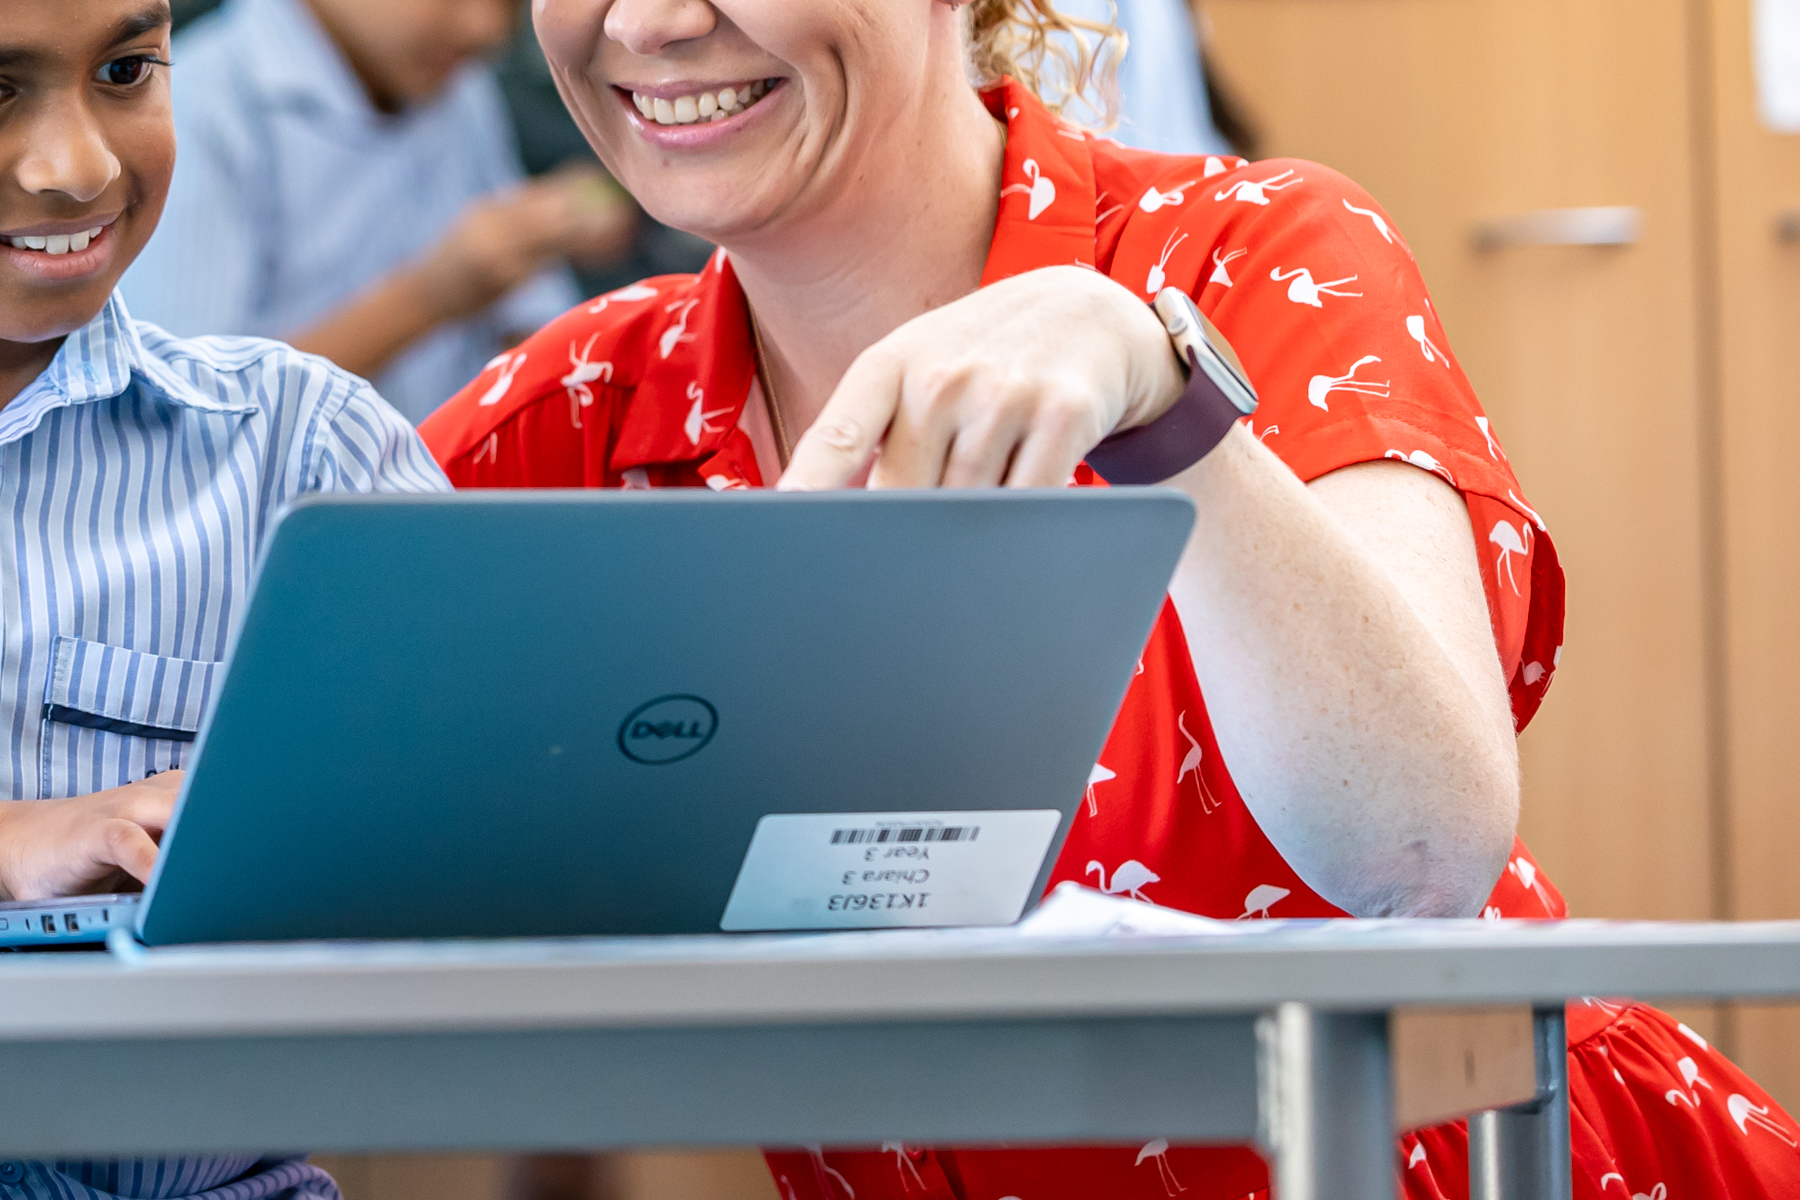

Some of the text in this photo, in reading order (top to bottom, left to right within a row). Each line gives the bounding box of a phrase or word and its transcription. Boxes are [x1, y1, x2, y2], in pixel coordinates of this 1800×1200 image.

[631, 721, 703, 739] DELL
[864, 846, 930, 862] Year 3
[841, 868, 931, 885] Chiara 3
[827, 892, 931, 911] 1K136J3
